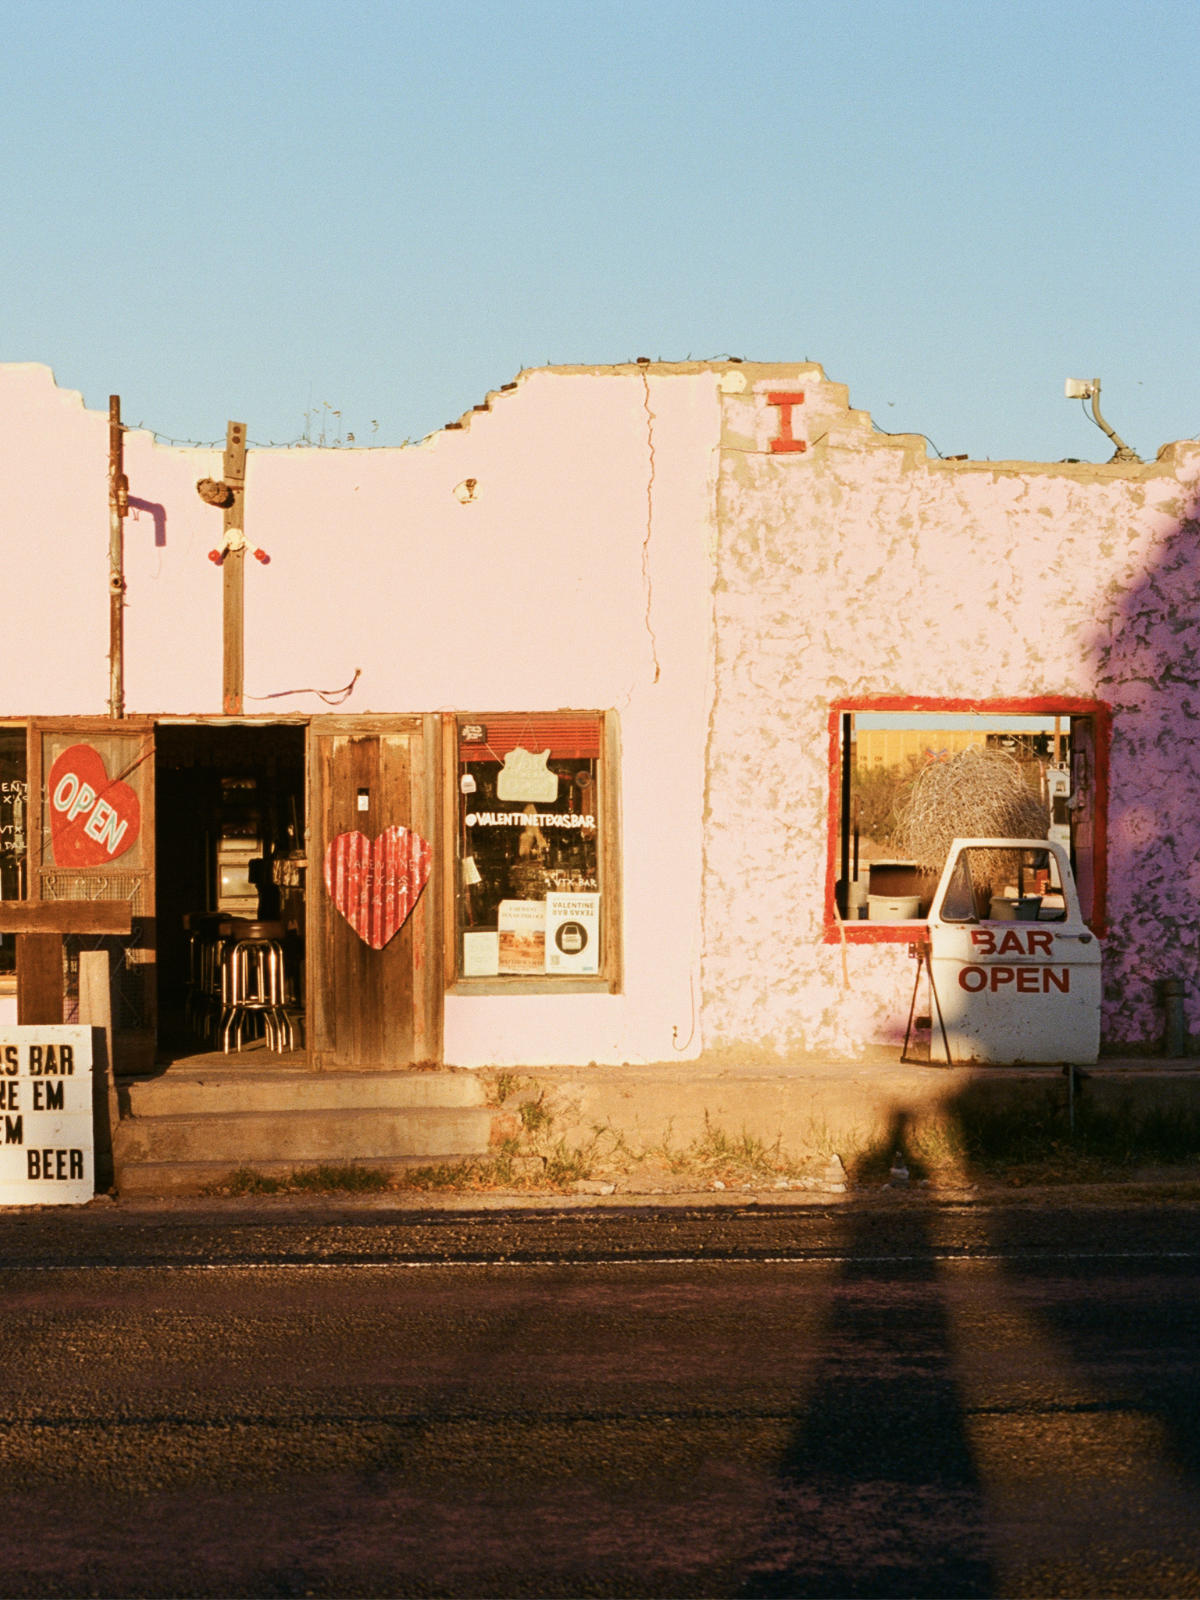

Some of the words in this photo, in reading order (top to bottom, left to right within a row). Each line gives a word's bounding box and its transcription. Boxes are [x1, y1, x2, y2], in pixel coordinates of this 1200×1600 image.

[53, 772, 129, 854] OPEN
[971, 930, 1054, 956] BAR
[958, 966, 1070, 993] OPEN
[29, 1045, 74, 1075] BAR
[33, 1081, 64, 1111] EM
[28, 1149, 84, 1180] BEER
